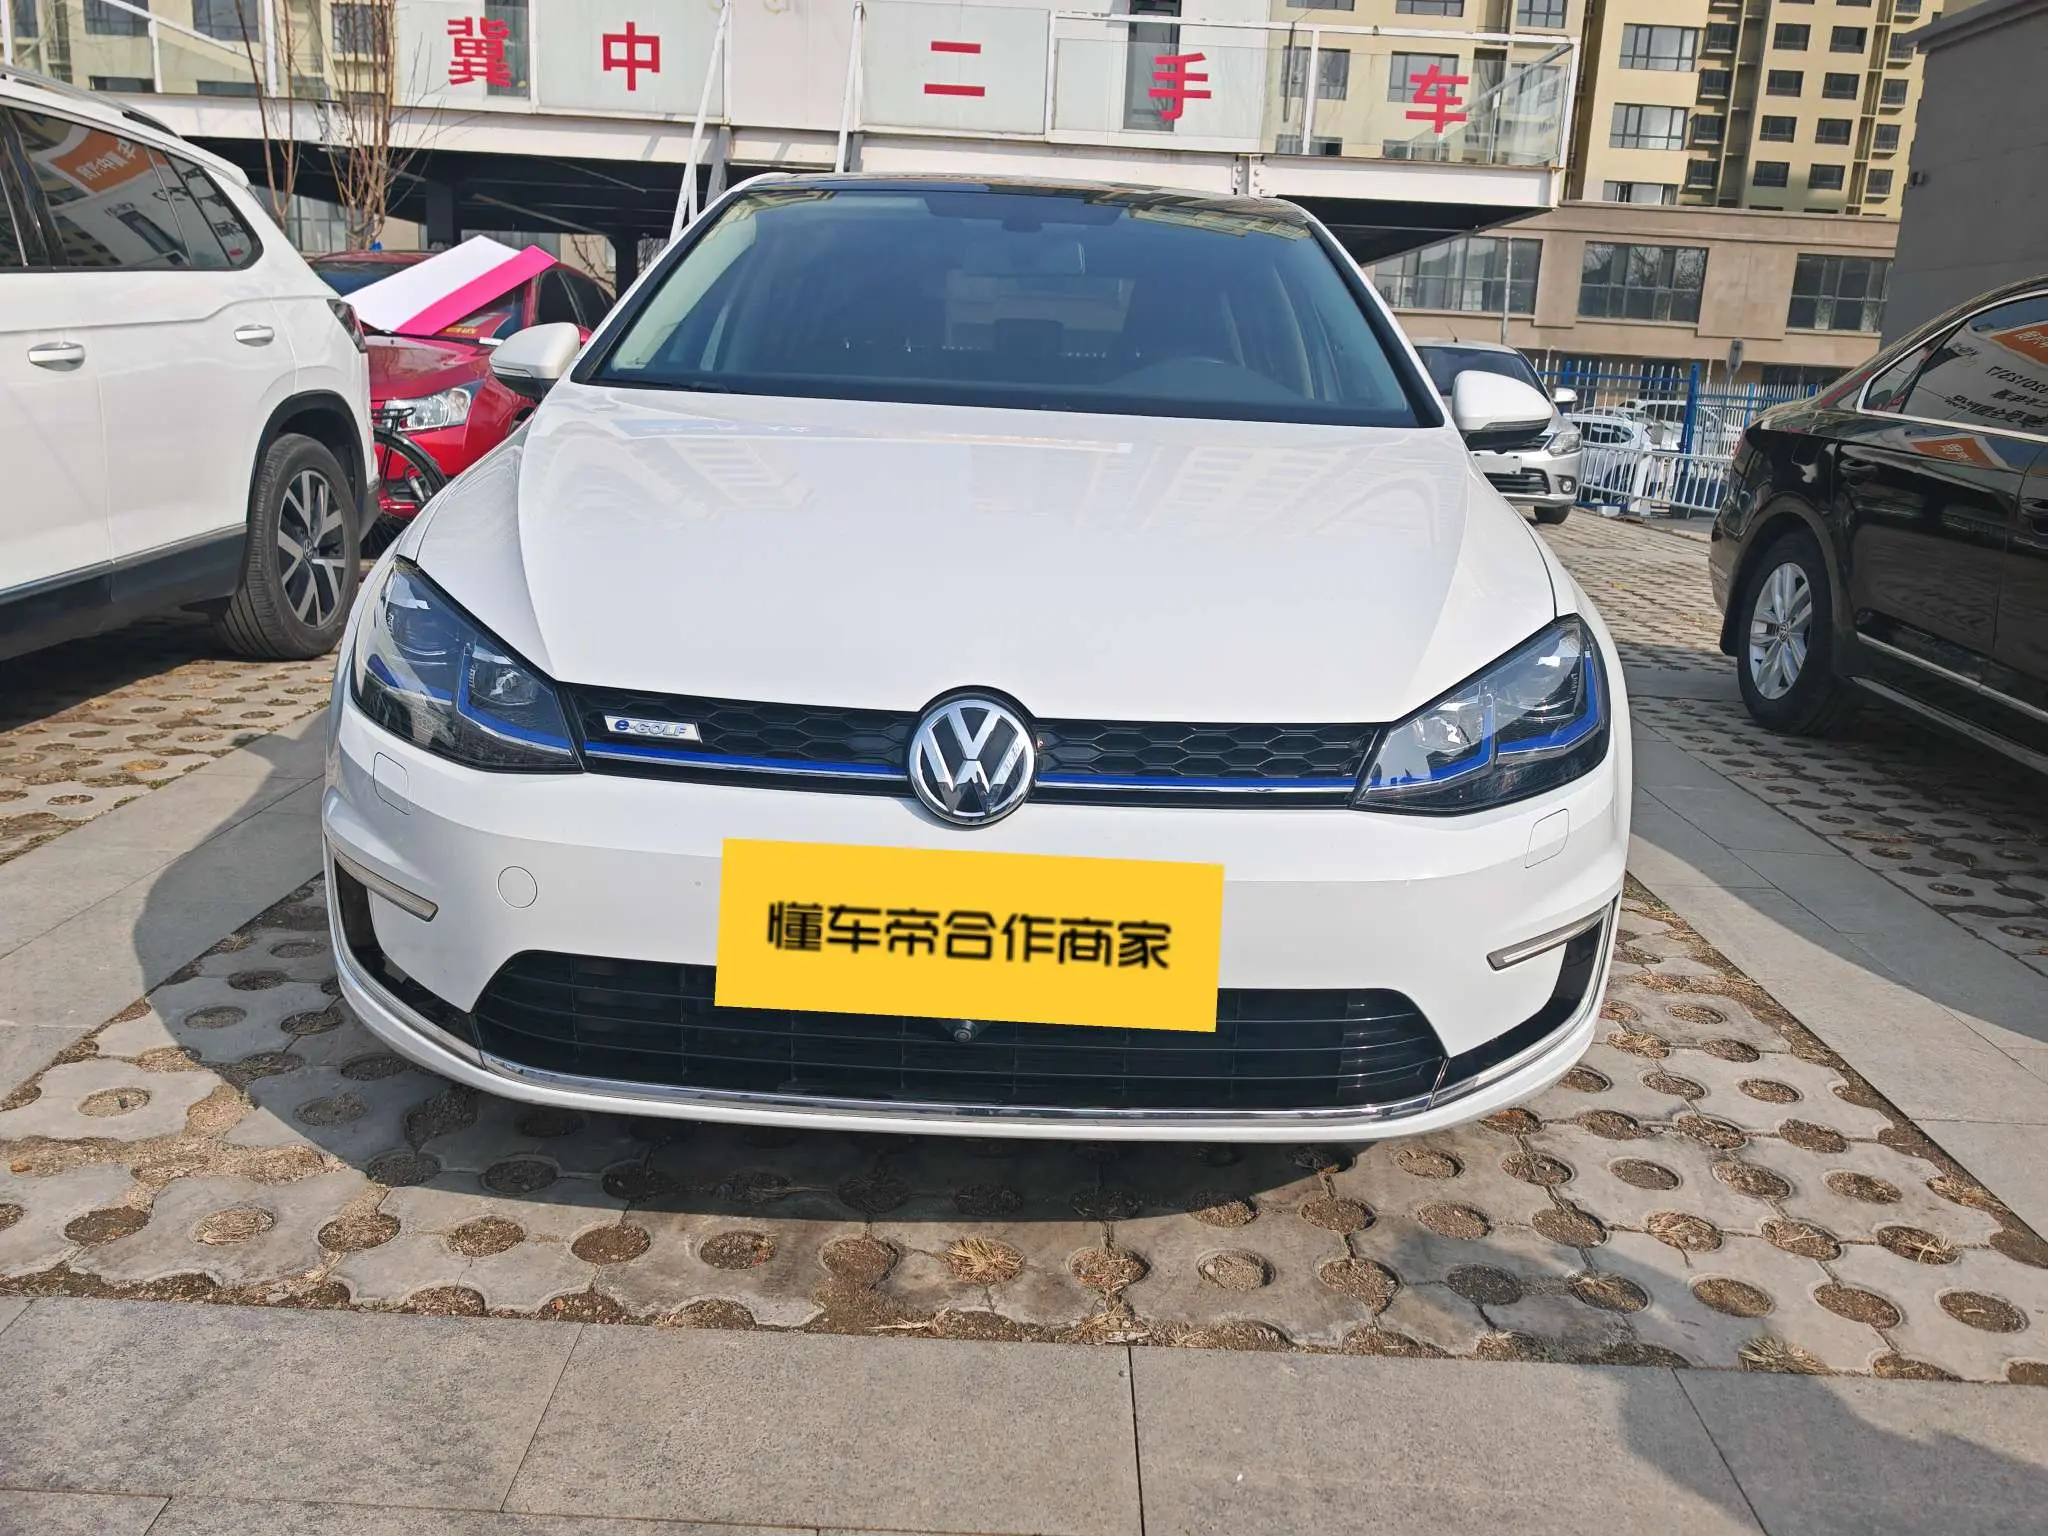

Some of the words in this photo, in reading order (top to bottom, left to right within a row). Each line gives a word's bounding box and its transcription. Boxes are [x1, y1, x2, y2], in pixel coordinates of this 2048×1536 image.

[447, 16, 1470, 134] 冀中二手车
